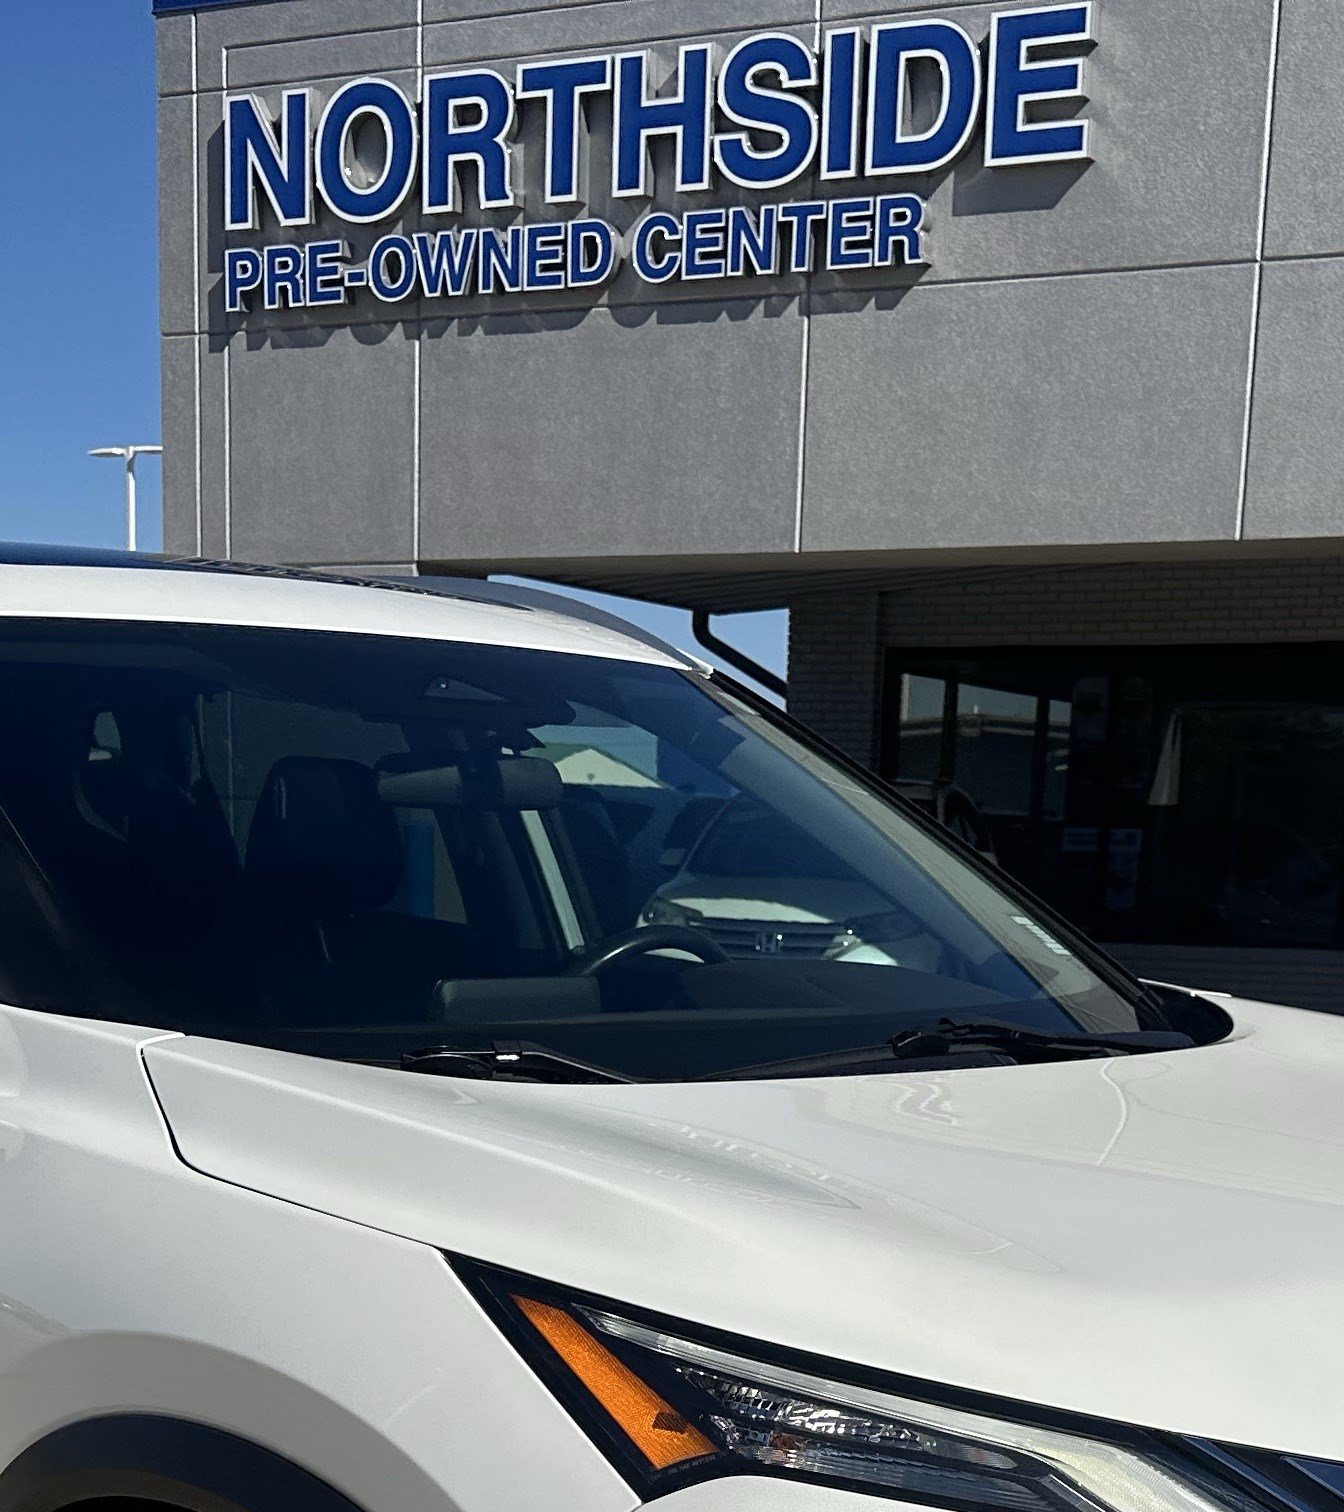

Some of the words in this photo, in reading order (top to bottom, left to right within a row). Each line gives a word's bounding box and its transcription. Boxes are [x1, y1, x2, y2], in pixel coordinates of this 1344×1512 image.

[223, 2, 1093, 231] NORTHSIDE
[223, 218, 614, 313] PRE-OWNED
[630, 195, 924, 282] CENTER
